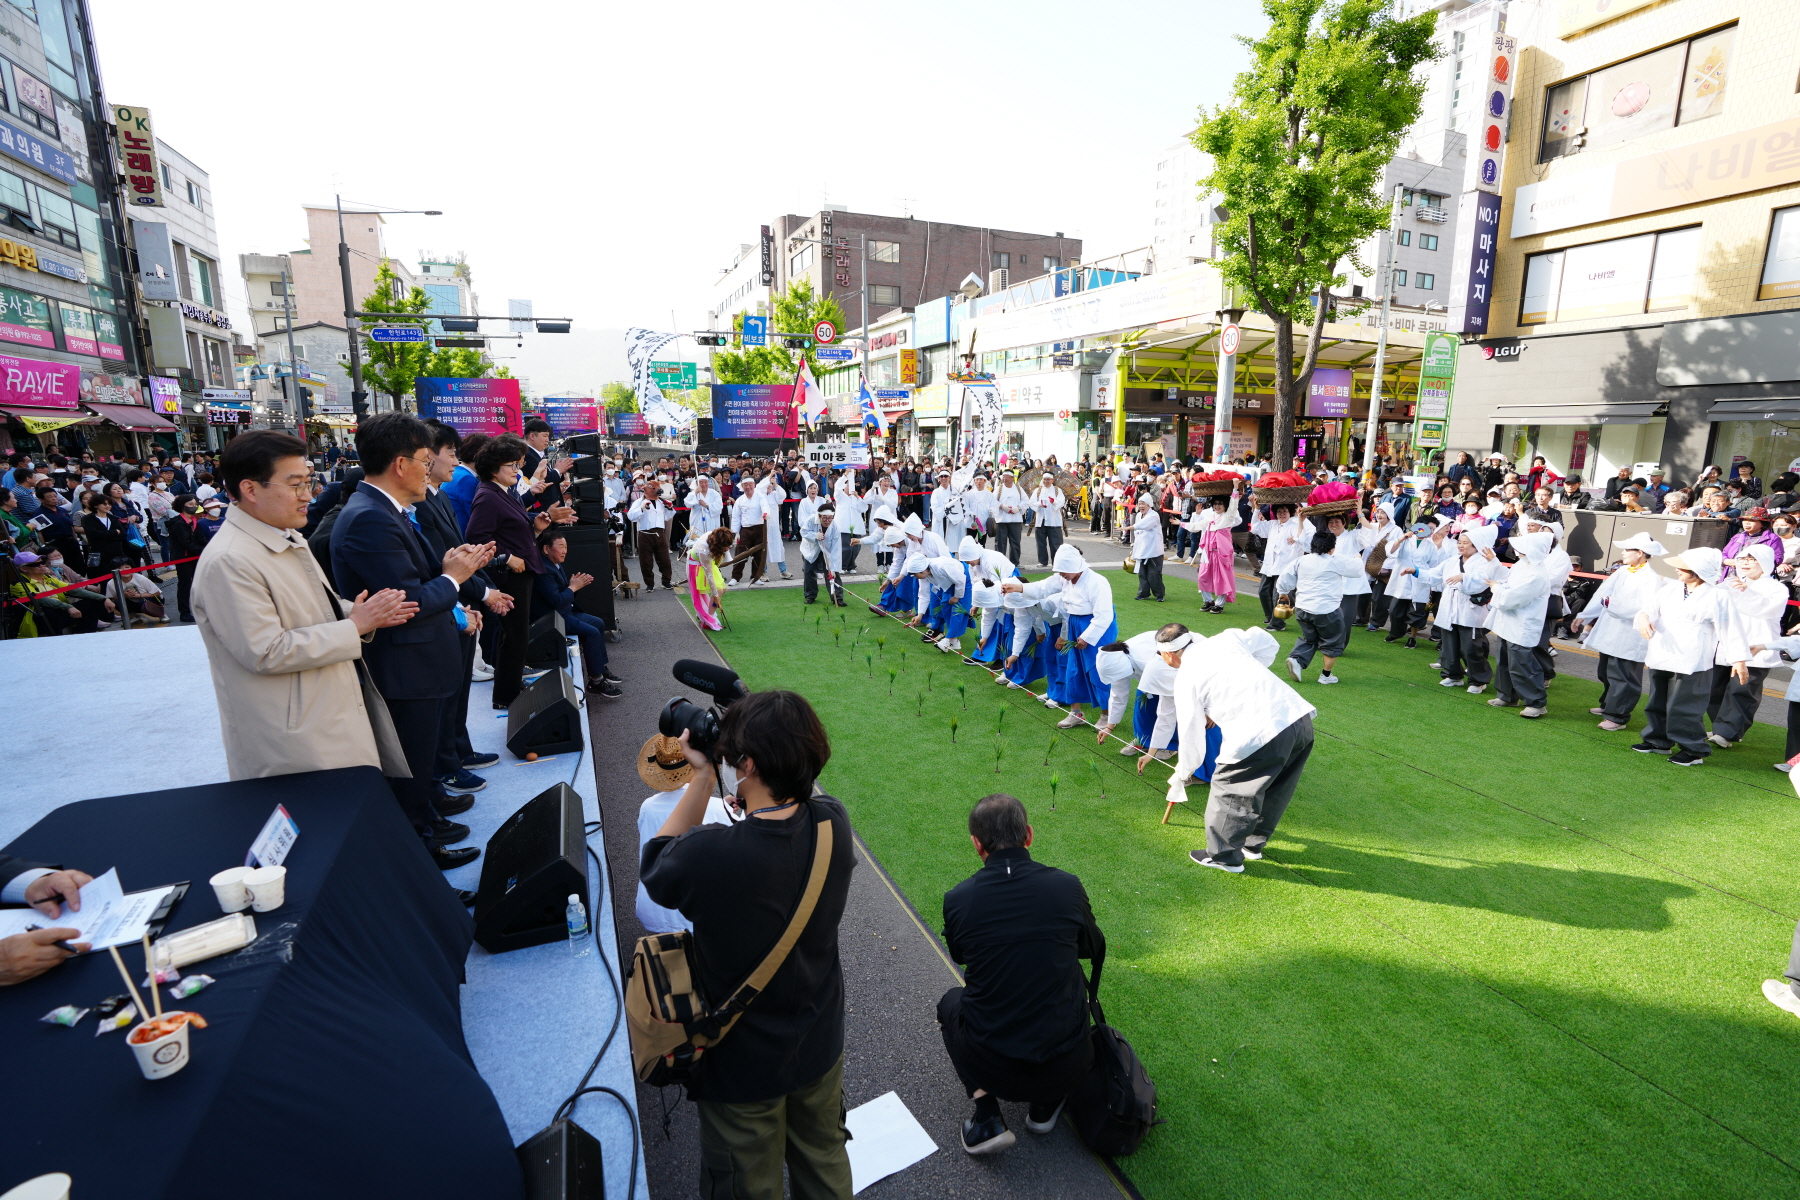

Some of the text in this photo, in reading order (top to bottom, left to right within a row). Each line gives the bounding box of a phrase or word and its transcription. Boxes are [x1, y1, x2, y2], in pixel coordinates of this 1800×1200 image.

[117, 107, 149, 131] OK
[54, 153, 65, 166] 3F
[123, 131, 156, 194] 노래방
[836, 236, 850, 287] 노래방
[1473, 234, 1493, 304] 마사지
[1588, 269, 1616, 281] 나비엘
[1470, 316, 1483, 326] 지하
[818, 327, 832, 338] 50
[743, 334, 765, 344] 비보호
[1224, 332, 1236, 347] 30
[1435, 380, 1447, 390] 01
[165, 401, 178, 413] OK
[1058, 409, 1070, 423] 약
[810, 452, 847, 462] 미아동
[1674, 526, 1683, 535] 3
[692, 675, 716, 690] BOYA
